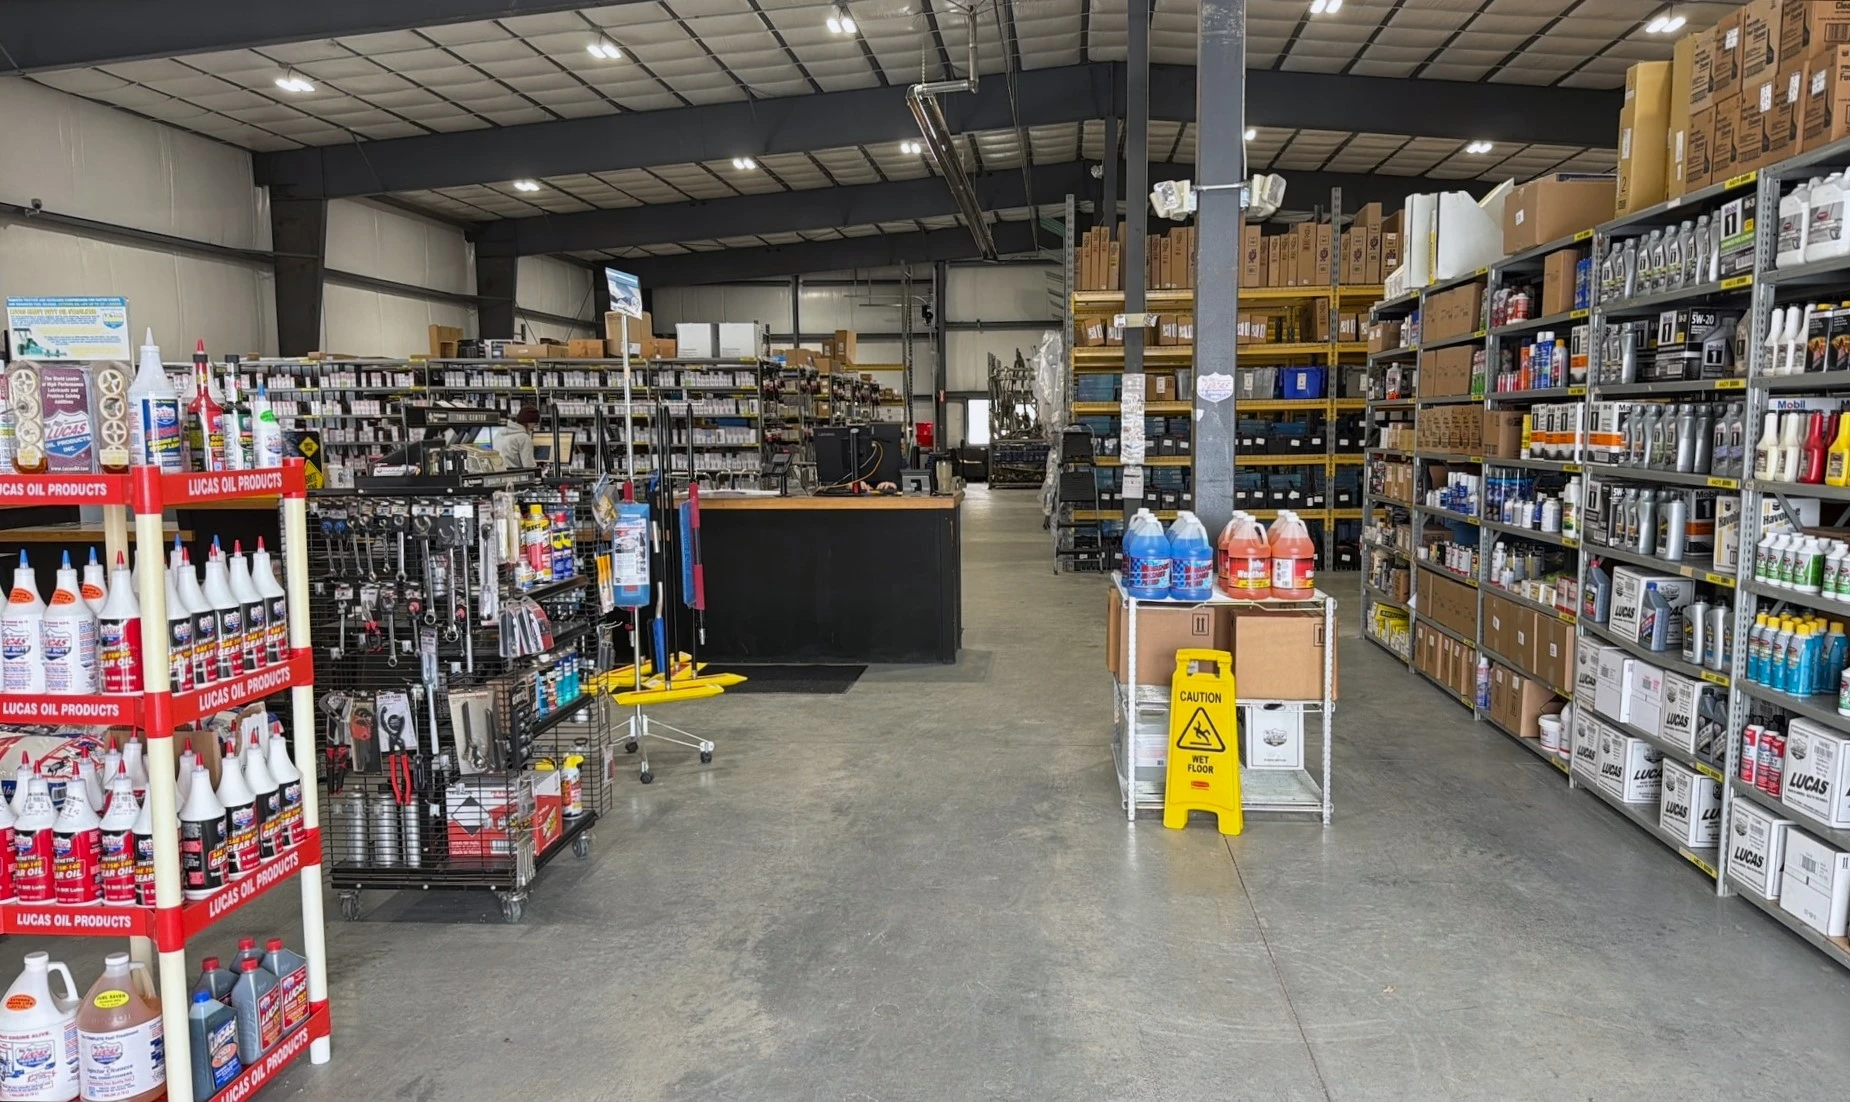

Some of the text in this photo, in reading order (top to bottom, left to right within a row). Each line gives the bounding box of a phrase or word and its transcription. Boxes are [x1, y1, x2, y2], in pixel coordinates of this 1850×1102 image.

[1691, 314, 1715, 325] 5W-20
[1777, 400, 1806, 409] Mobil
[47, 423, 87, 440] LUCAS
[45, 436, 91, 449] OIL PRODUCTS
[0, 483, 108, 497] CAS OIL PRODUCTS
[188, 472, 282, 496] LUCAS OIL PRODUCTS
[1615, 605, 1636, 619] LUCAS
[199, 666, 291, 711] LUCAS OIL PRODUCTS
[1180, 691, 1222, 703] CAUTION
[3, 702, 120, 717] LUCAS OIL PRODUCTS
[1666, 712, 1690, 728] LUCAS
[1192, 755, 1209, 764] WET
[1577, 745, 1596, 761] LUCAS
[1188, 764, 1214, 774] FLOOR
[1602, 762, 1622, 778] LUCAS
[1633, 767, 1663, 781] LUCA
[1789, 771, 1829, 795] LUCAS
[1665, 801, 1688, 818] LUCAS
[227, 840, 250, 853] GEAR
[1734, 846, 1765, 869] LUCAS
[27, 867, 44, 877] OIL
[65, 868, 83, 879] OIL
[101, 865, 134, 877] EAR OIL
[209, 851, 300, 918] LUCAS OIL PRODUCTS
[17, 912, 132, 928] LUCAS OIL PRODUCTS
[285, 979, 307, 1004] LUCAS
[261, 998, 280, 1026] LUCAS
[210, 1019, 236, 1053] LUCAS
[220, 1076, 250, 1102] UCAS
[251, 1068, 266, 1084] OIL
[267, 1028, 309, 1074] PRODUCTS
